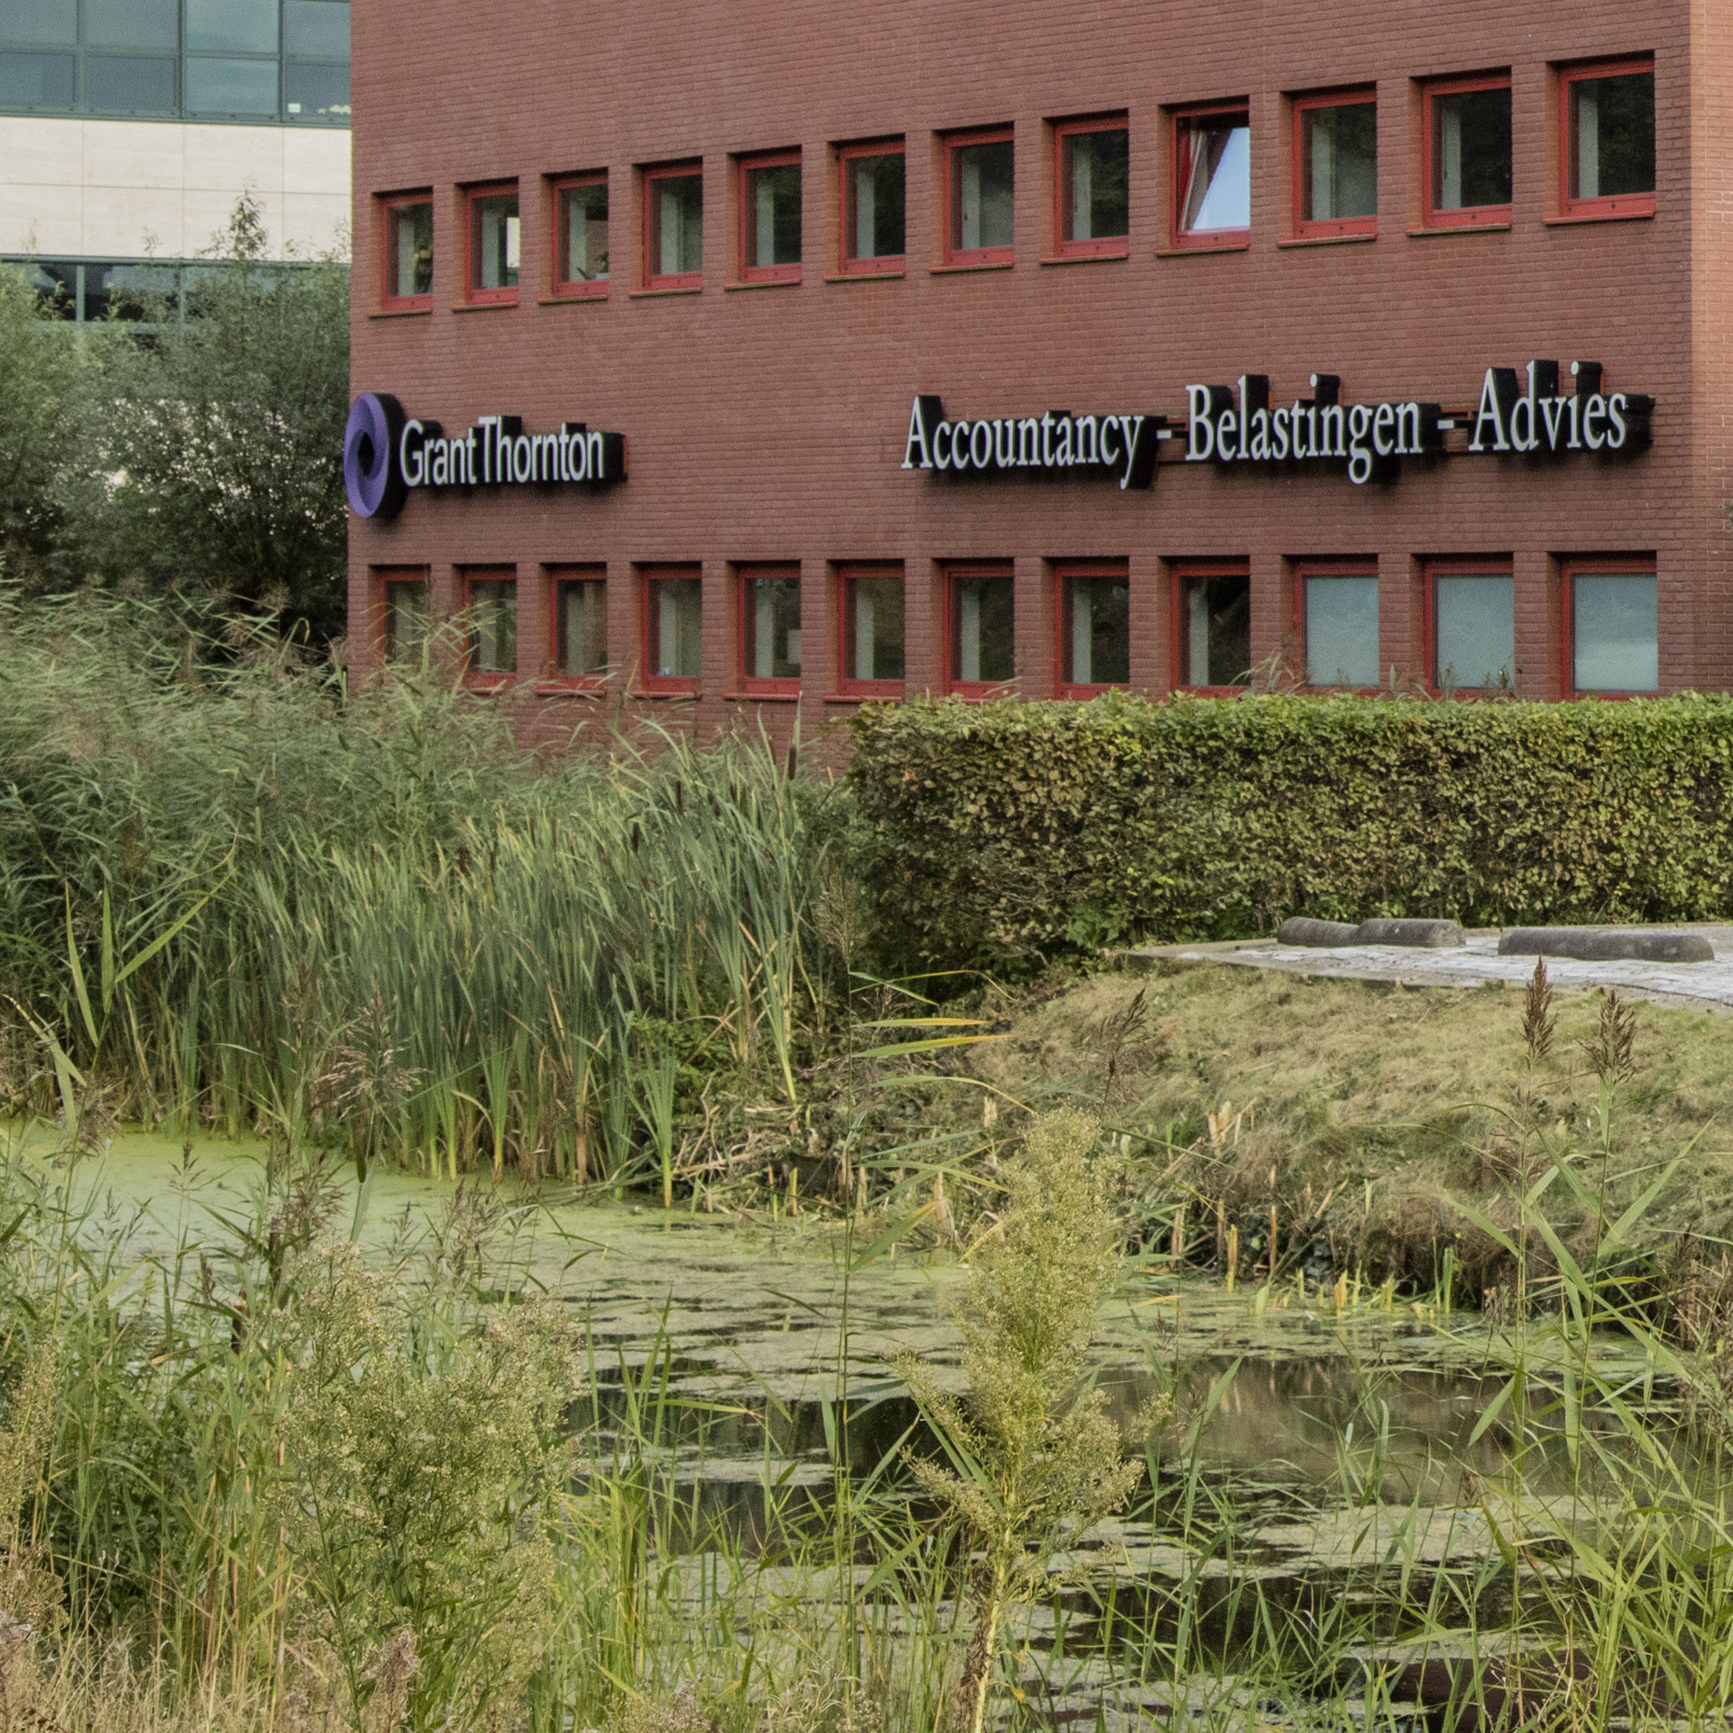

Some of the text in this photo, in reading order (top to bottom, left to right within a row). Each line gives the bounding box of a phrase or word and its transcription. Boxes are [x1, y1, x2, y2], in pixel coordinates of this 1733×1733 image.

[400, 415, 603, 486] Grant Thornton
[901, 395, 1144, 490] Accountancy
[1186, 374, 1424, 485] Belastingen
[1469, 360, 1627, 452] Advies
